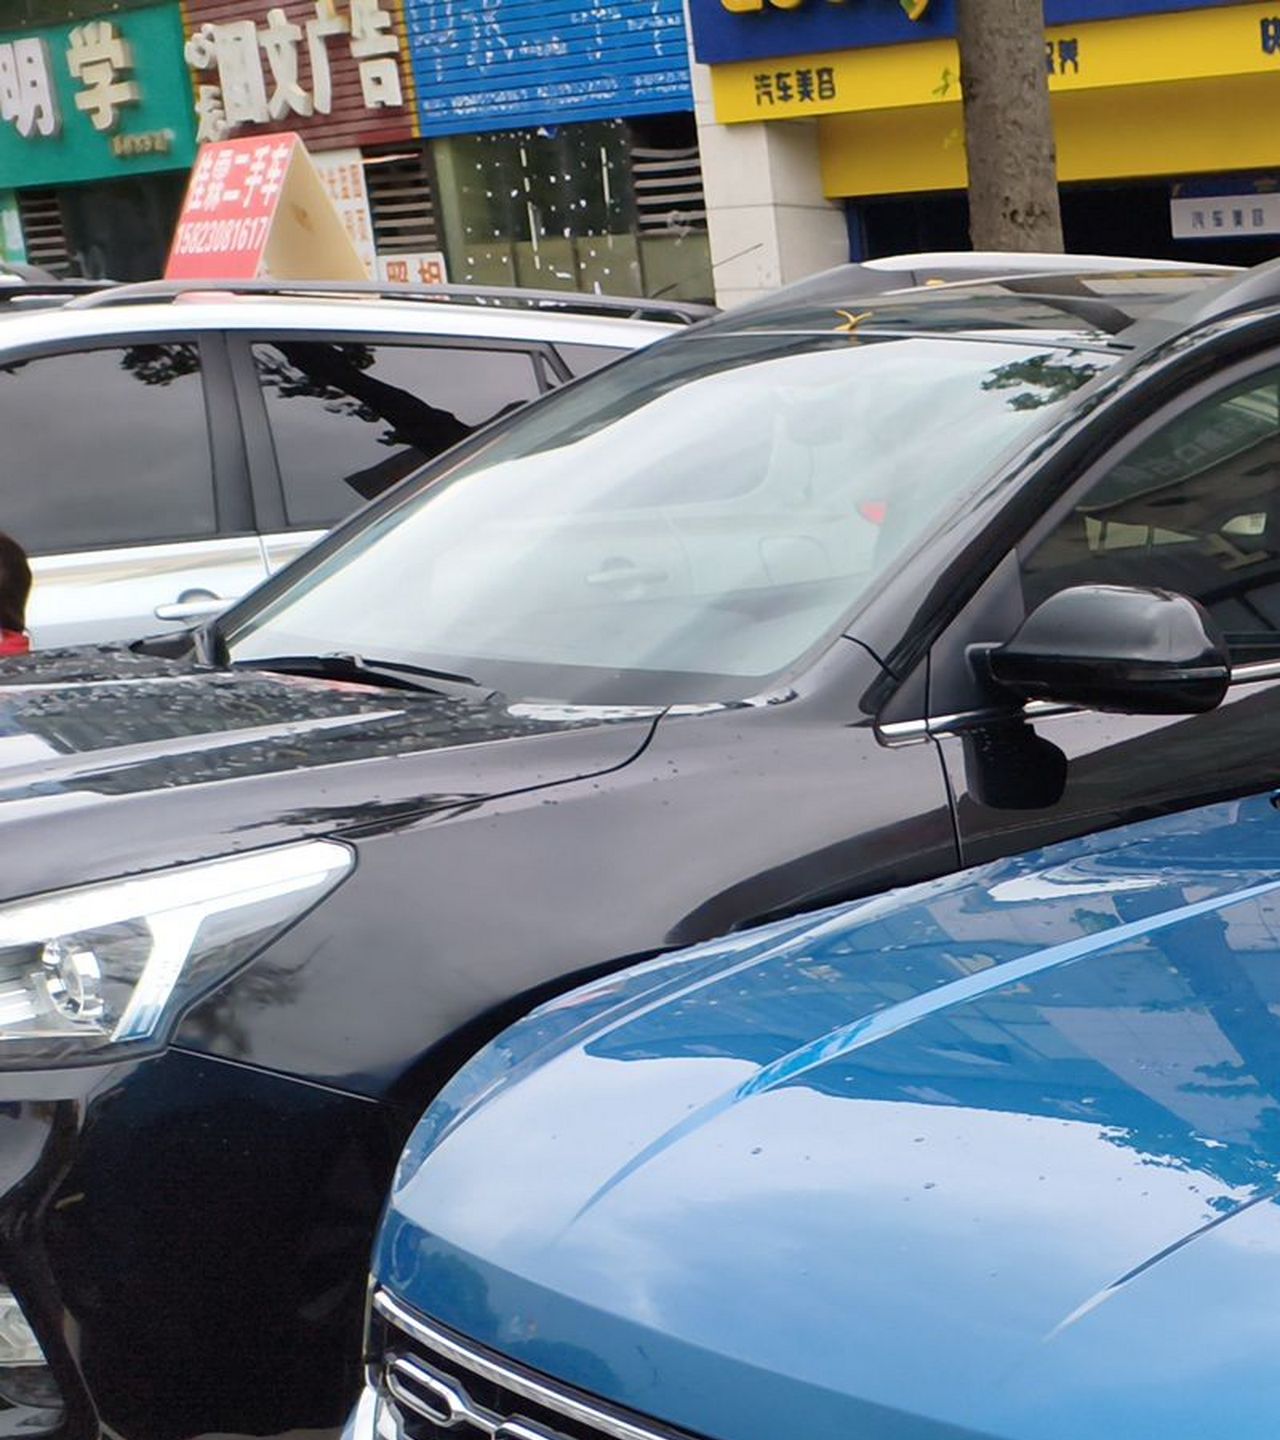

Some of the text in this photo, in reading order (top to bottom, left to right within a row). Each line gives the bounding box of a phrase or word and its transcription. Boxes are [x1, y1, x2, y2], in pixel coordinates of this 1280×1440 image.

[754, 67, 836, 106] 汽车美容
[188, 143, 291, 211] 佳霖二手车
[175, 214, 269, 254] 15823081617
